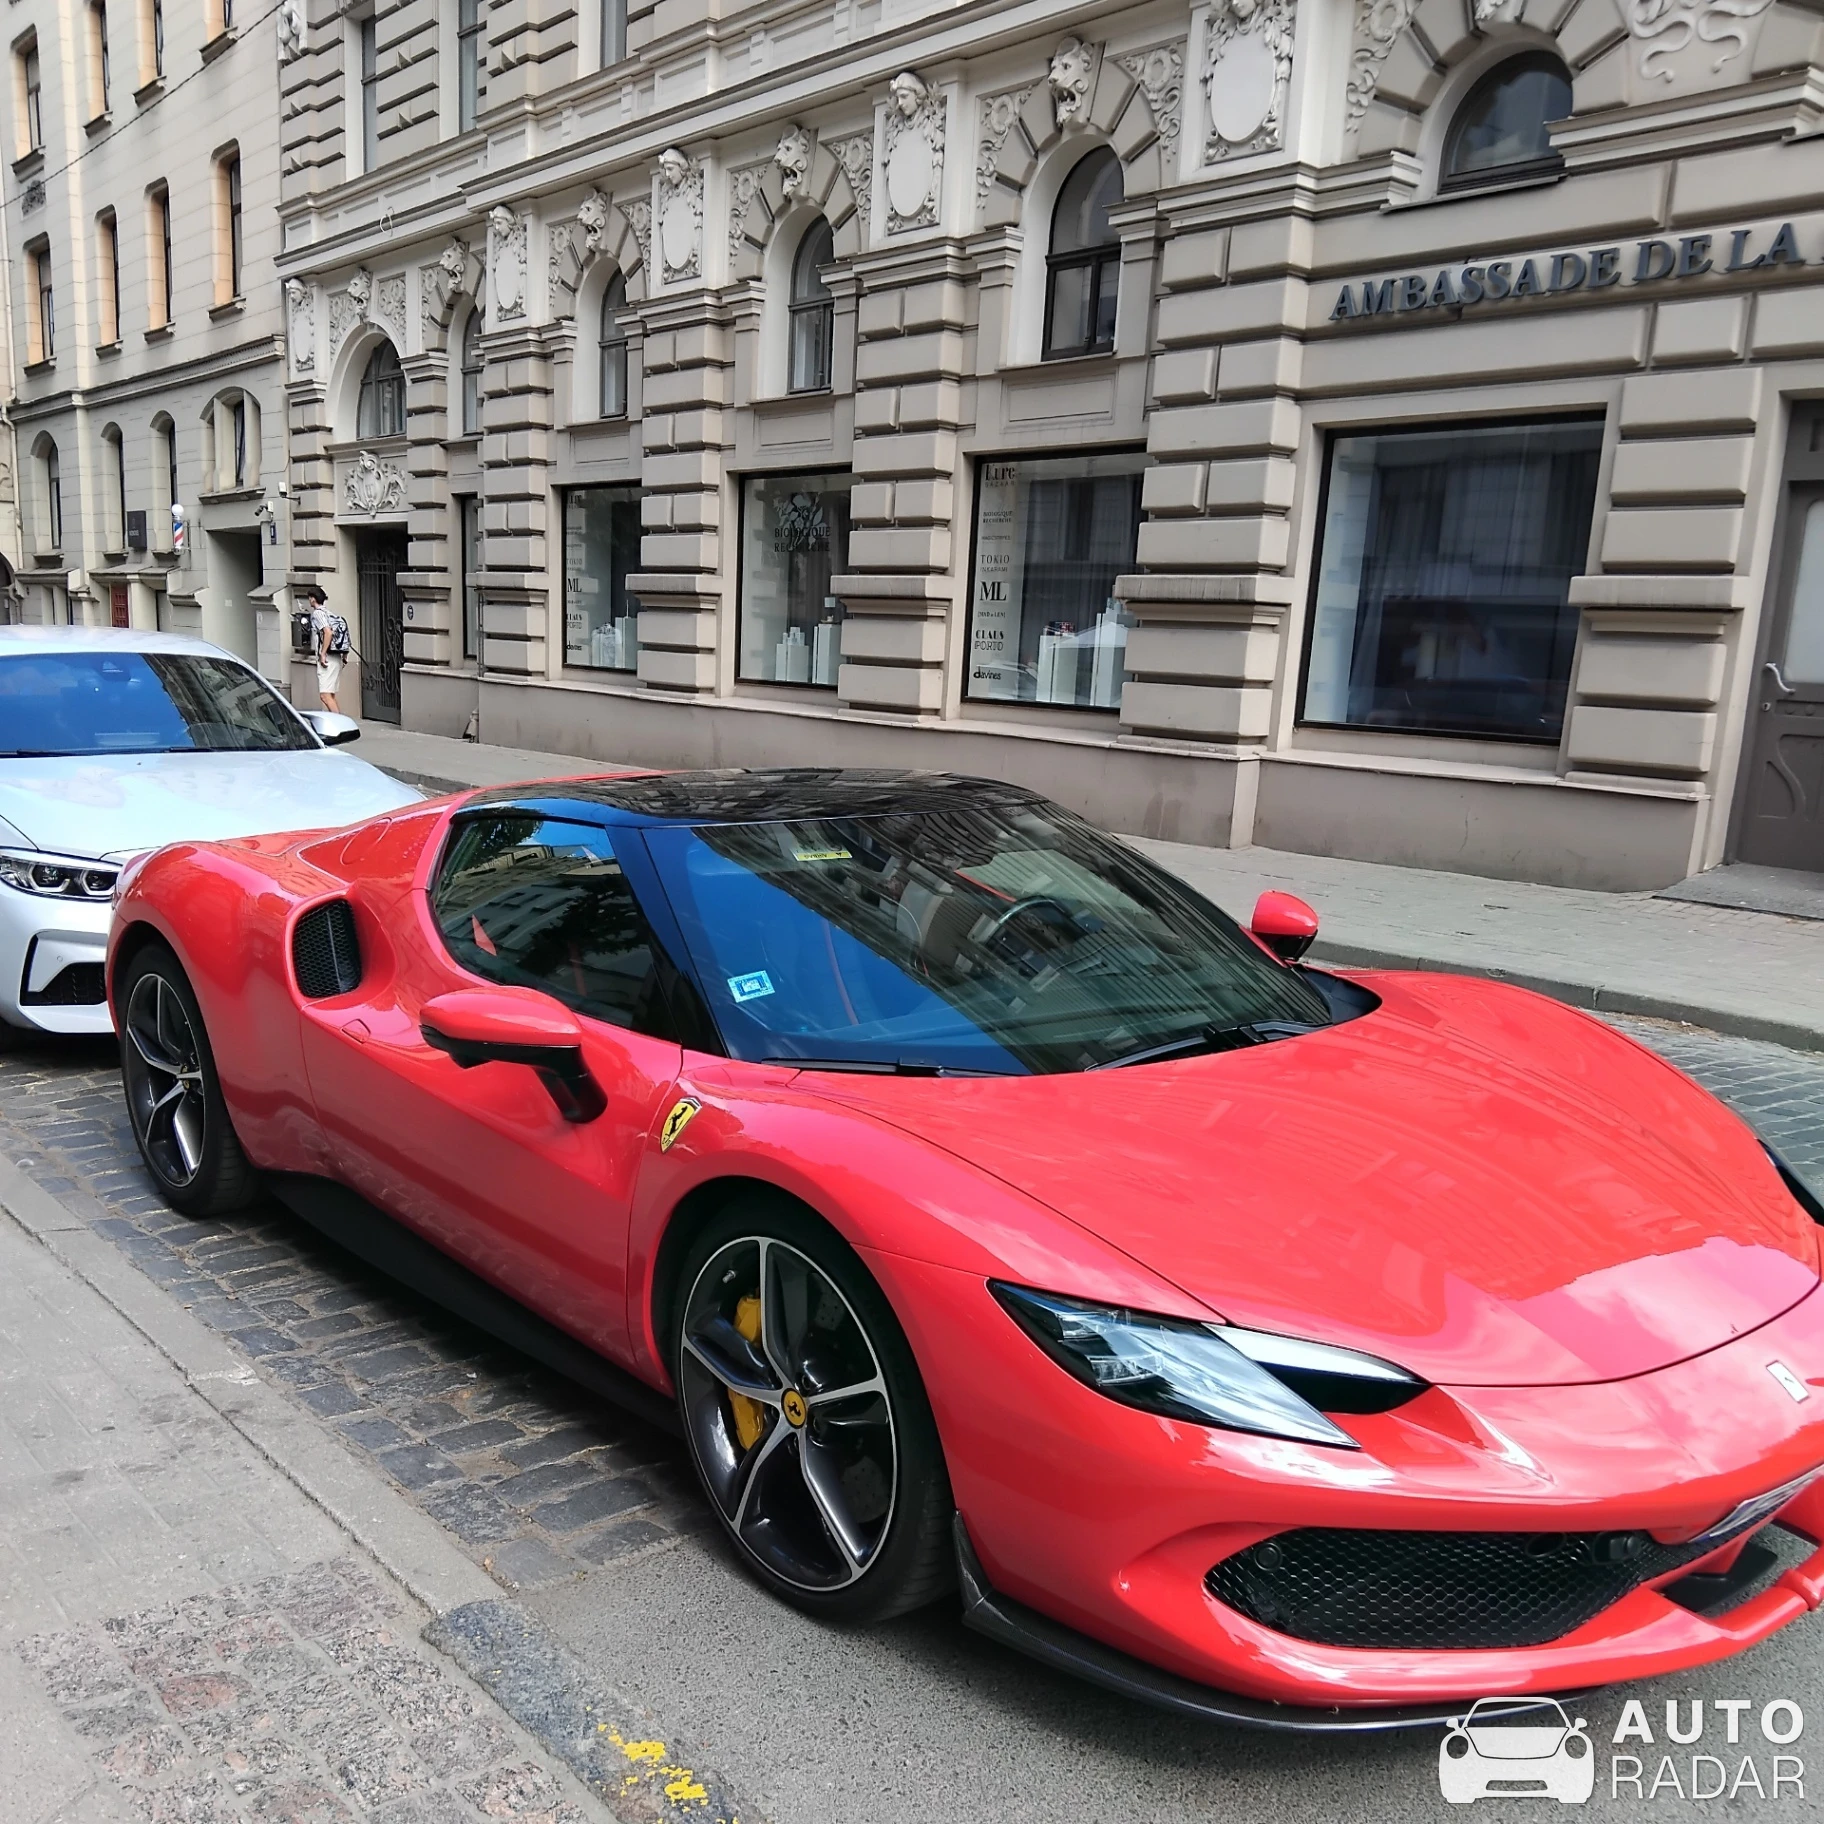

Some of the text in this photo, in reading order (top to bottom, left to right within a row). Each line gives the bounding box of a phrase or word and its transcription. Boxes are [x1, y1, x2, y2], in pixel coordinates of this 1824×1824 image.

[1329, 222, 1806, 321] AMBASSADE DE LA
[774, 541, 830, 552] RECCHE
[980, 554, 1010, 564] TOKIO
[567, 578, 582, 593] ML
[979, 581, 1007, 601] ML
[975, 629, 1004, 640] CLAUS
[974, 640, 1004, 651] PORTO
[973, 665, 1002, 680] davines
